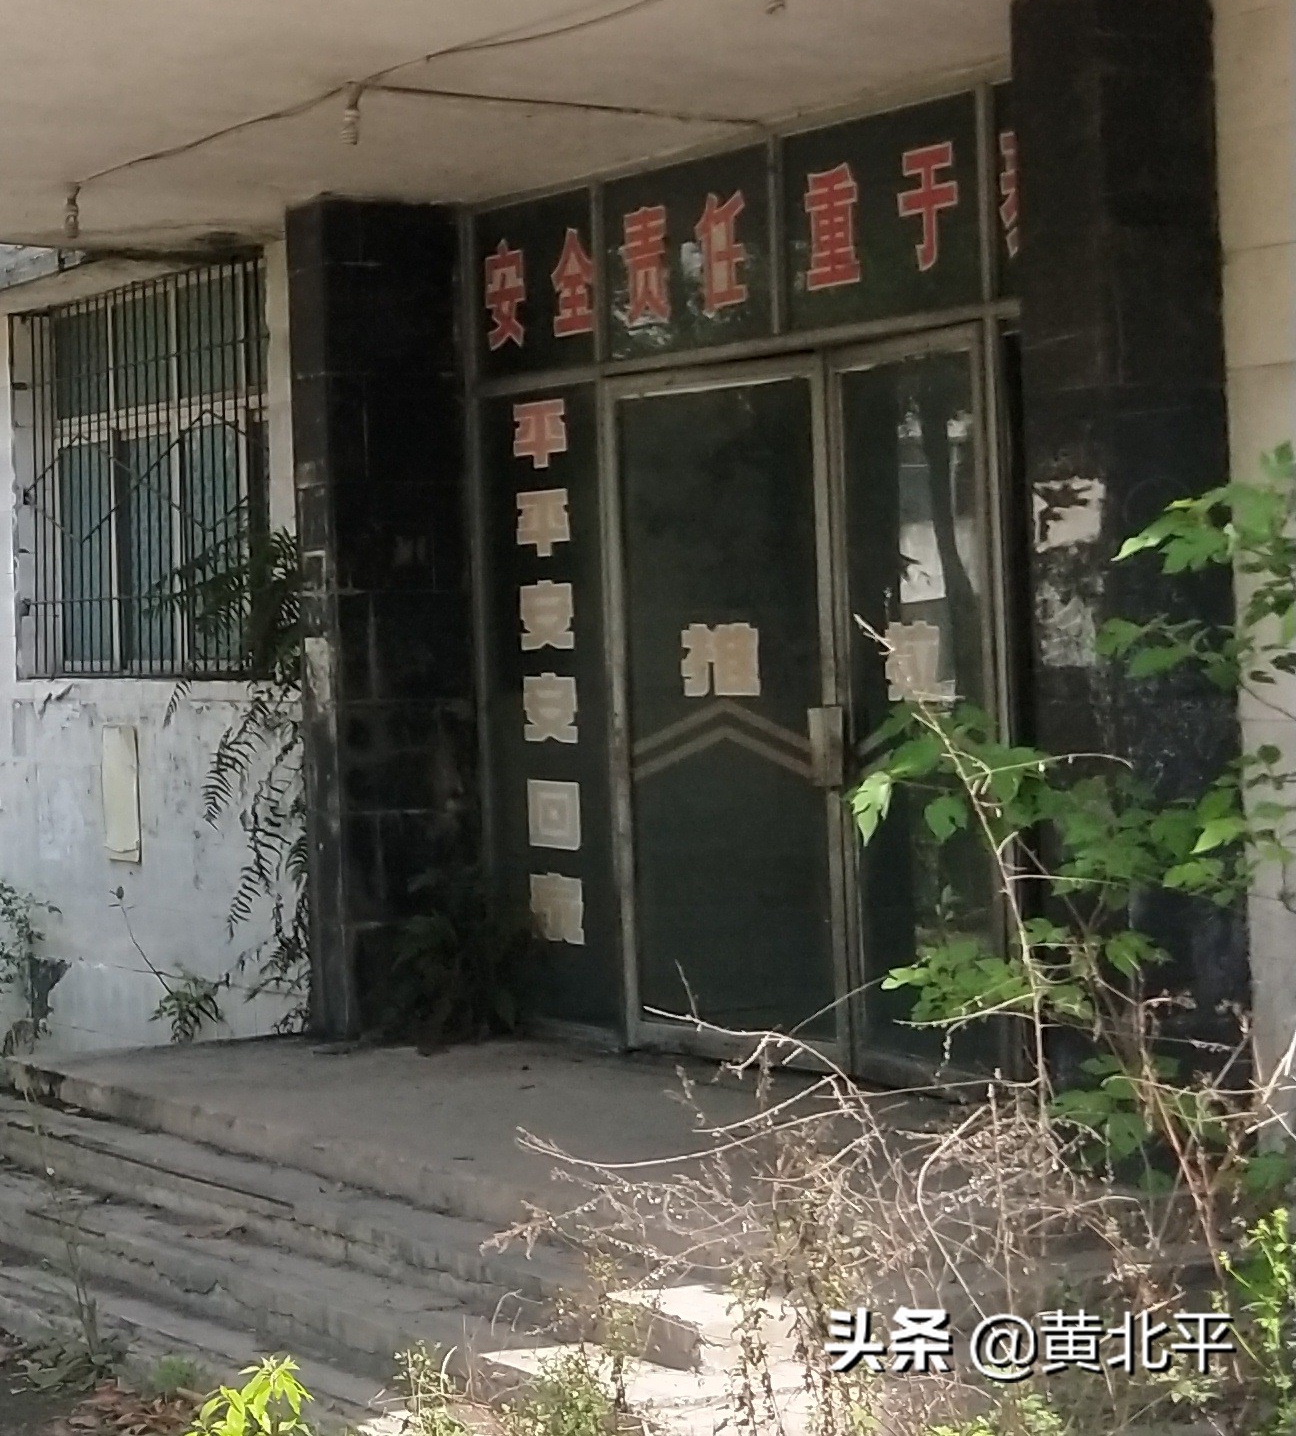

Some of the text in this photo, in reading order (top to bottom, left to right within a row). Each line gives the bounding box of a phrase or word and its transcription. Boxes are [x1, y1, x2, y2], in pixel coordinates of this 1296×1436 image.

[484, 131, 1019, 351] 安全责任重于
[513, 398, 585, 945] 平平安安回家
[681, 622, 761, 697] 推
[884, 620, 955, 702] 拉
